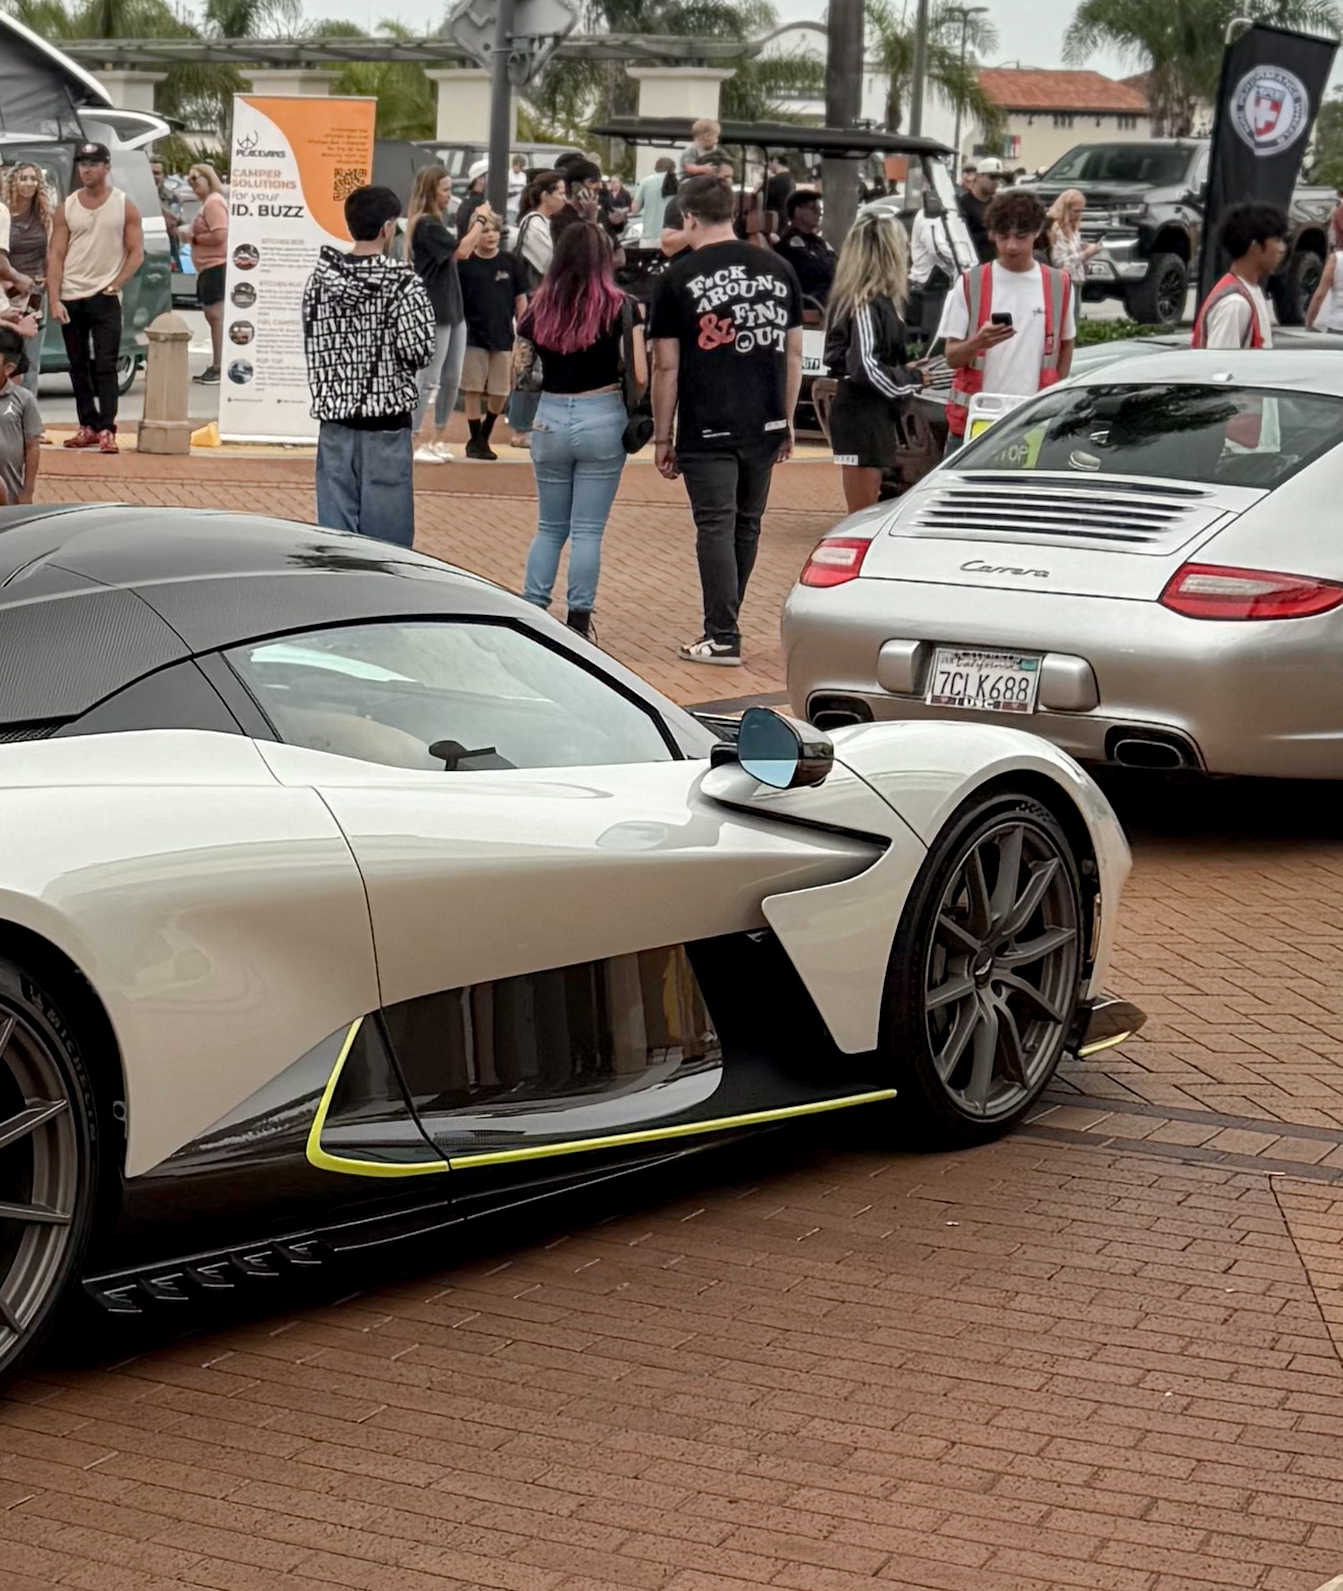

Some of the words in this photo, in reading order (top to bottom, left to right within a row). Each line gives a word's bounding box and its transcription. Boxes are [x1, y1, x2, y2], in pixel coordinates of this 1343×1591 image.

[232, 169, 281, 179] CAMPER
[231, 178, 297, 190] SOLUTIONS
[231, 190, 248, 201] for
[250, 191, 280, 203] your
[231, 204, 254, 217] ID.
[258, 205, 305, 218] BUZZ
[696, 275, 788, 313] AROUND
[732, 301, 788, 327] FIND
[960, 560, 1050, 578] Carrera
[939, 671, 1030, 702] 7CLK688
